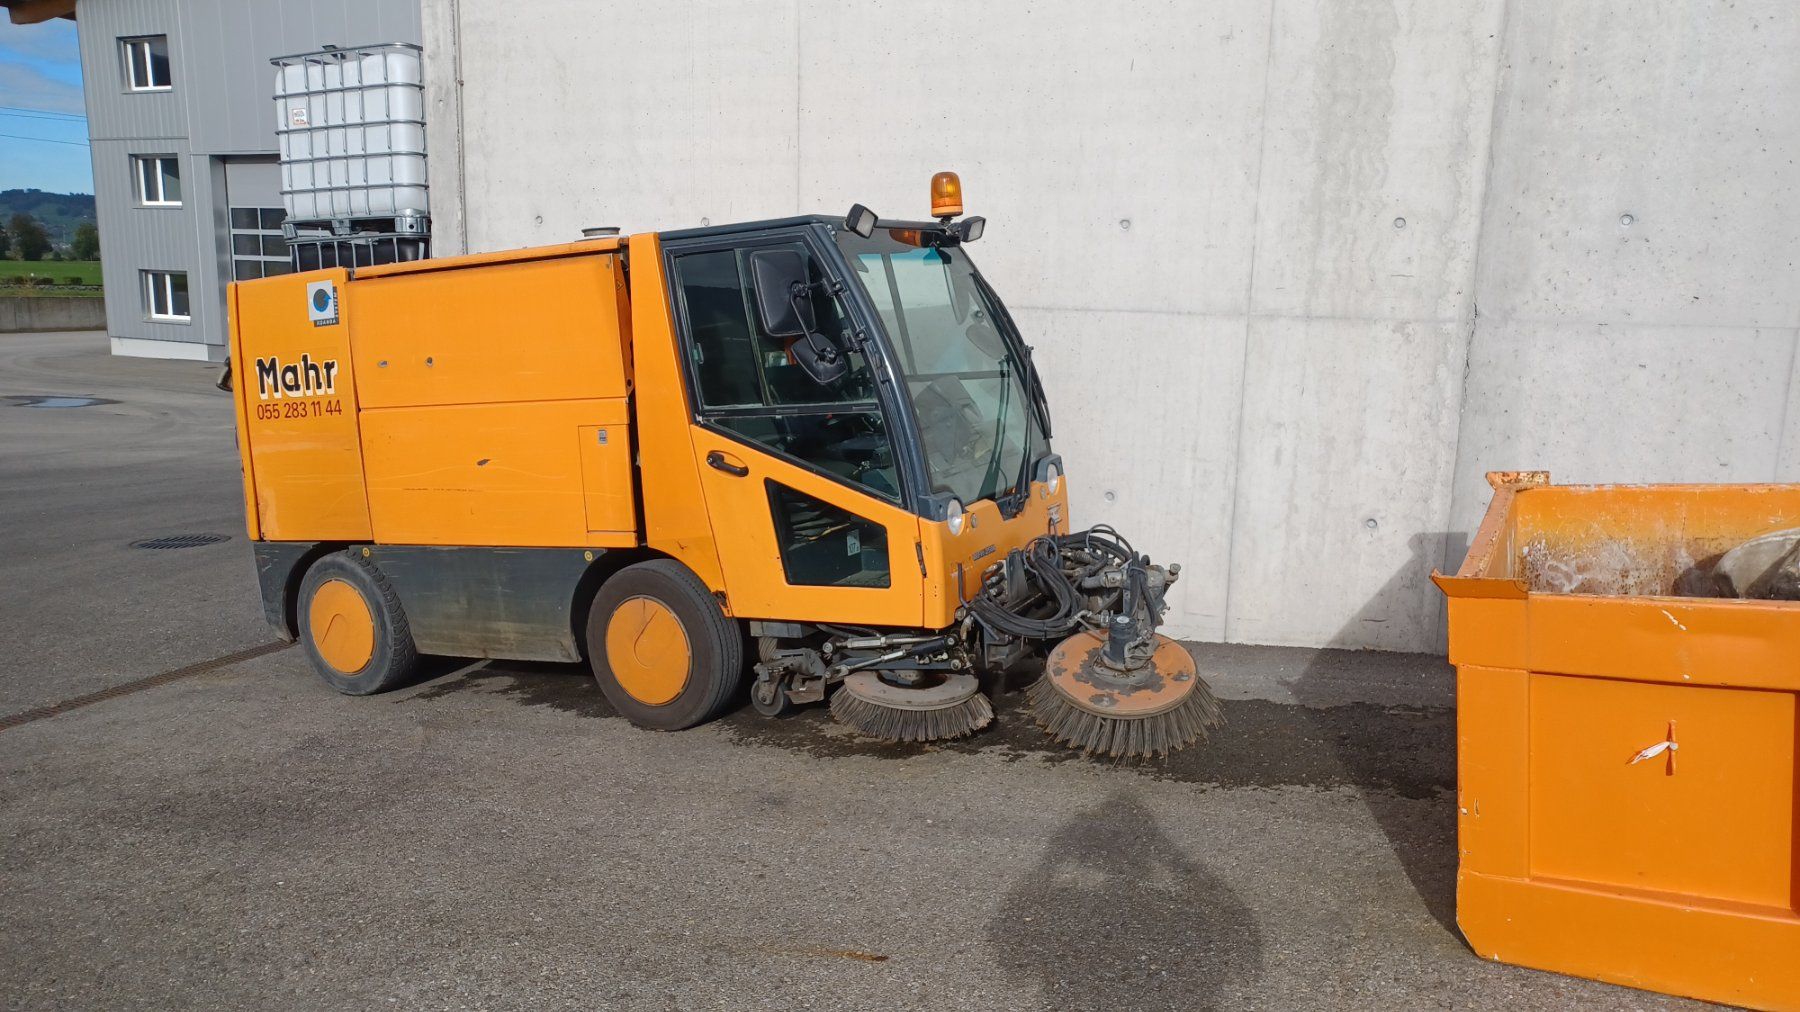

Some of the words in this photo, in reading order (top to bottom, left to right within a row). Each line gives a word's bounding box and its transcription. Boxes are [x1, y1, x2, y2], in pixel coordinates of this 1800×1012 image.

[256, 353, 338, 398] Mahr
[257, 403, 280, 420] 055
[283, 401, 307, 419] 283
[311, 400, 322, 417] 11
[325, 399, 342, 416] 44
